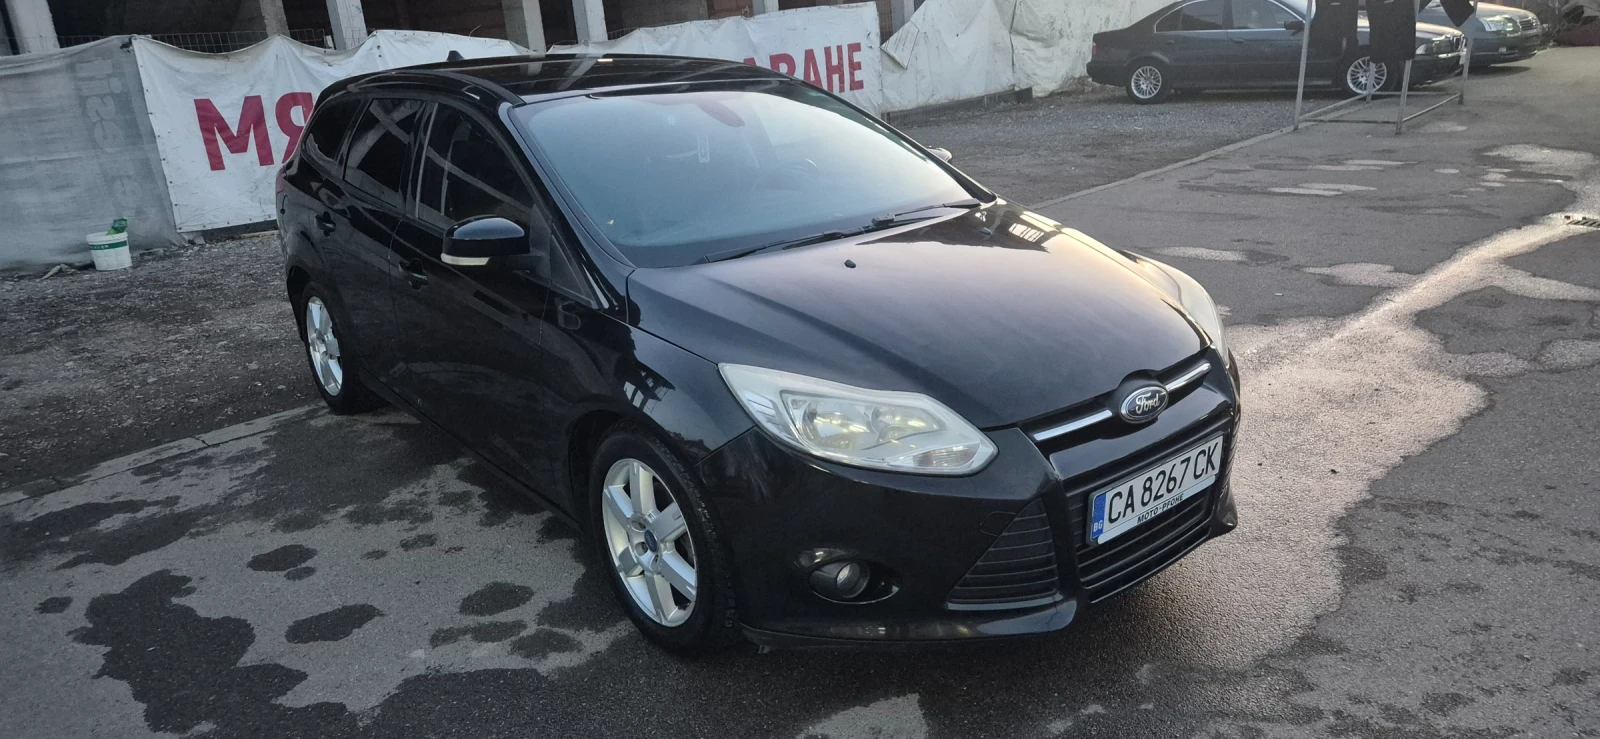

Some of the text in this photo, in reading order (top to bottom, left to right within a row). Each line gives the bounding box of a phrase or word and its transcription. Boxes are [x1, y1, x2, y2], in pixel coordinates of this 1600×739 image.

[1136, 392, 1160, 414] Ford
[1108, 442, 1218, 523] CA 8267 CK
[1093, 521, 1103, 532] BG
